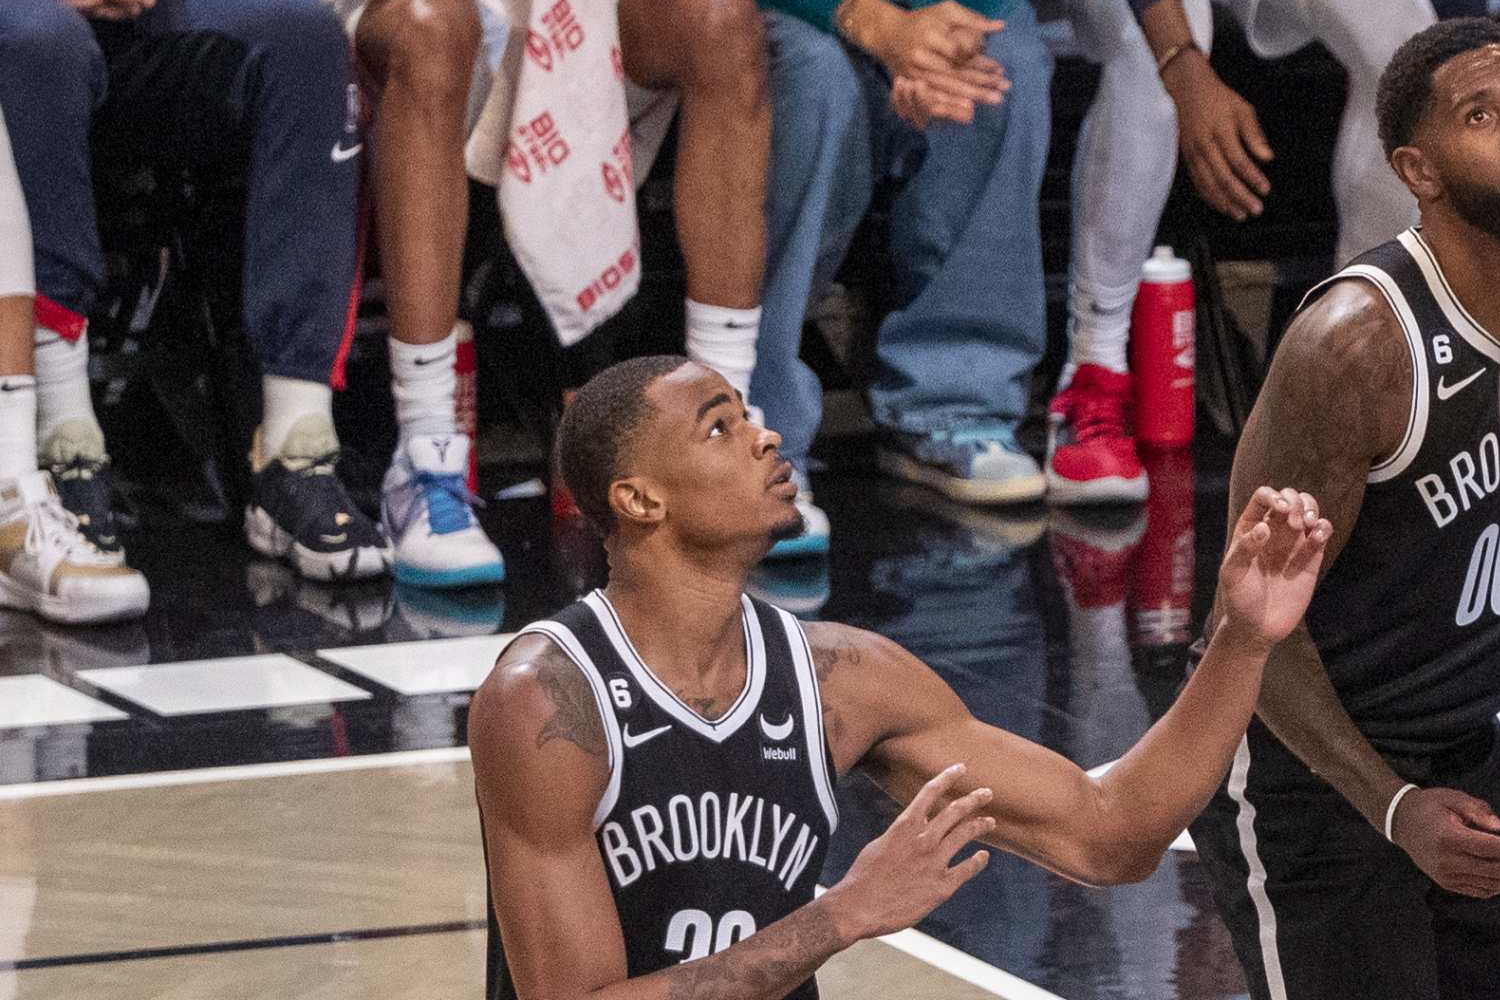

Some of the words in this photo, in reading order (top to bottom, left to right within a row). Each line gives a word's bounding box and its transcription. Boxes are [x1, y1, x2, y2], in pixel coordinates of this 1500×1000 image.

[529, 110, 571, 168] BIO
[1432, 334, 1453, 365] 6
[609, 678, 632, 708] 6
[763, 746, 796, 760] Webull
[602, 791, 818, 892] BROOKLYN
